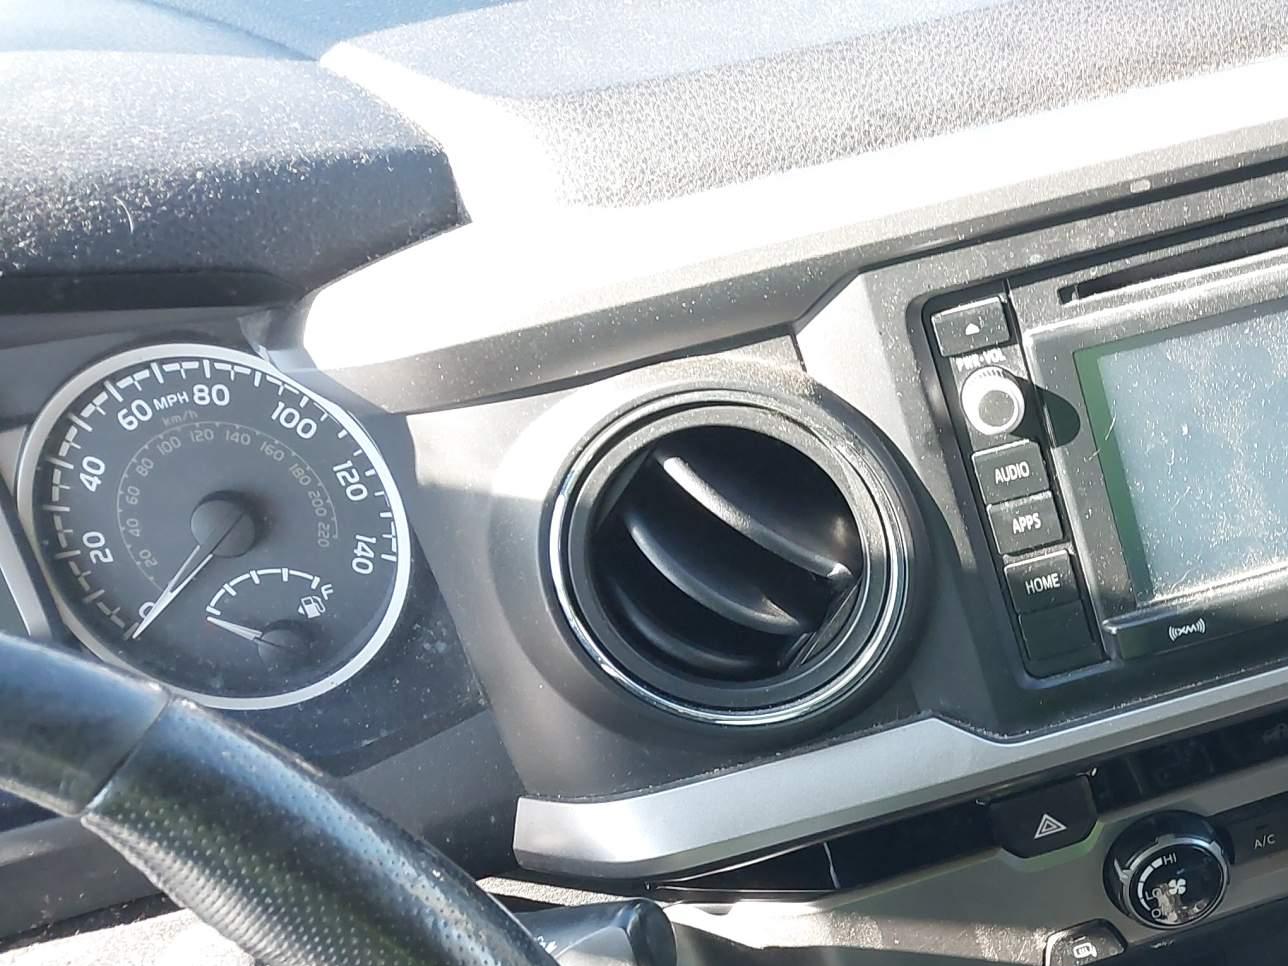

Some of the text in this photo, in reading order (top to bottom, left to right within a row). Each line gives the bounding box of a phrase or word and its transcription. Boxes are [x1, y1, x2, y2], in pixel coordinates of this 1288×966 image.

[152, 391, 190, 411] MPH
[192, 383, 231, 406] 80
[117, 399, 153, 431] 60
[162, 409, 198, 428] km/h
[271, 401, 317, 439] 100
[156, 436, 182, 456] 100
[190, 428, 214, 443] 120
[225, 429, 251, 446] 140
[260, 441, 285, 462] 160
[79, 455, 106, 492] 40
[135, 457, 155, 477] 80
[289, 463, 311, 486] 180
[994, 461, 1030, 484] AUDIO
[333, 460, 368, 501] 120
[125, 485, 140, 505] 60
[308, 490, 327, 517] 200
[126, 518, 140, 537] 40
[318, 521, 330, 548] 220
[1012, 512, 1042, 535] APPS
[82, 530, 114, 564] 20
[351, 534, 377, 575] 140
[139, 549, 158, 568] 20
[321, 584, 334, 600] F
[1025, 572, 1061, 595] HOME
[1254, 833, 1276, 849] A/C
[1163, 852, 1177, 865] HI
